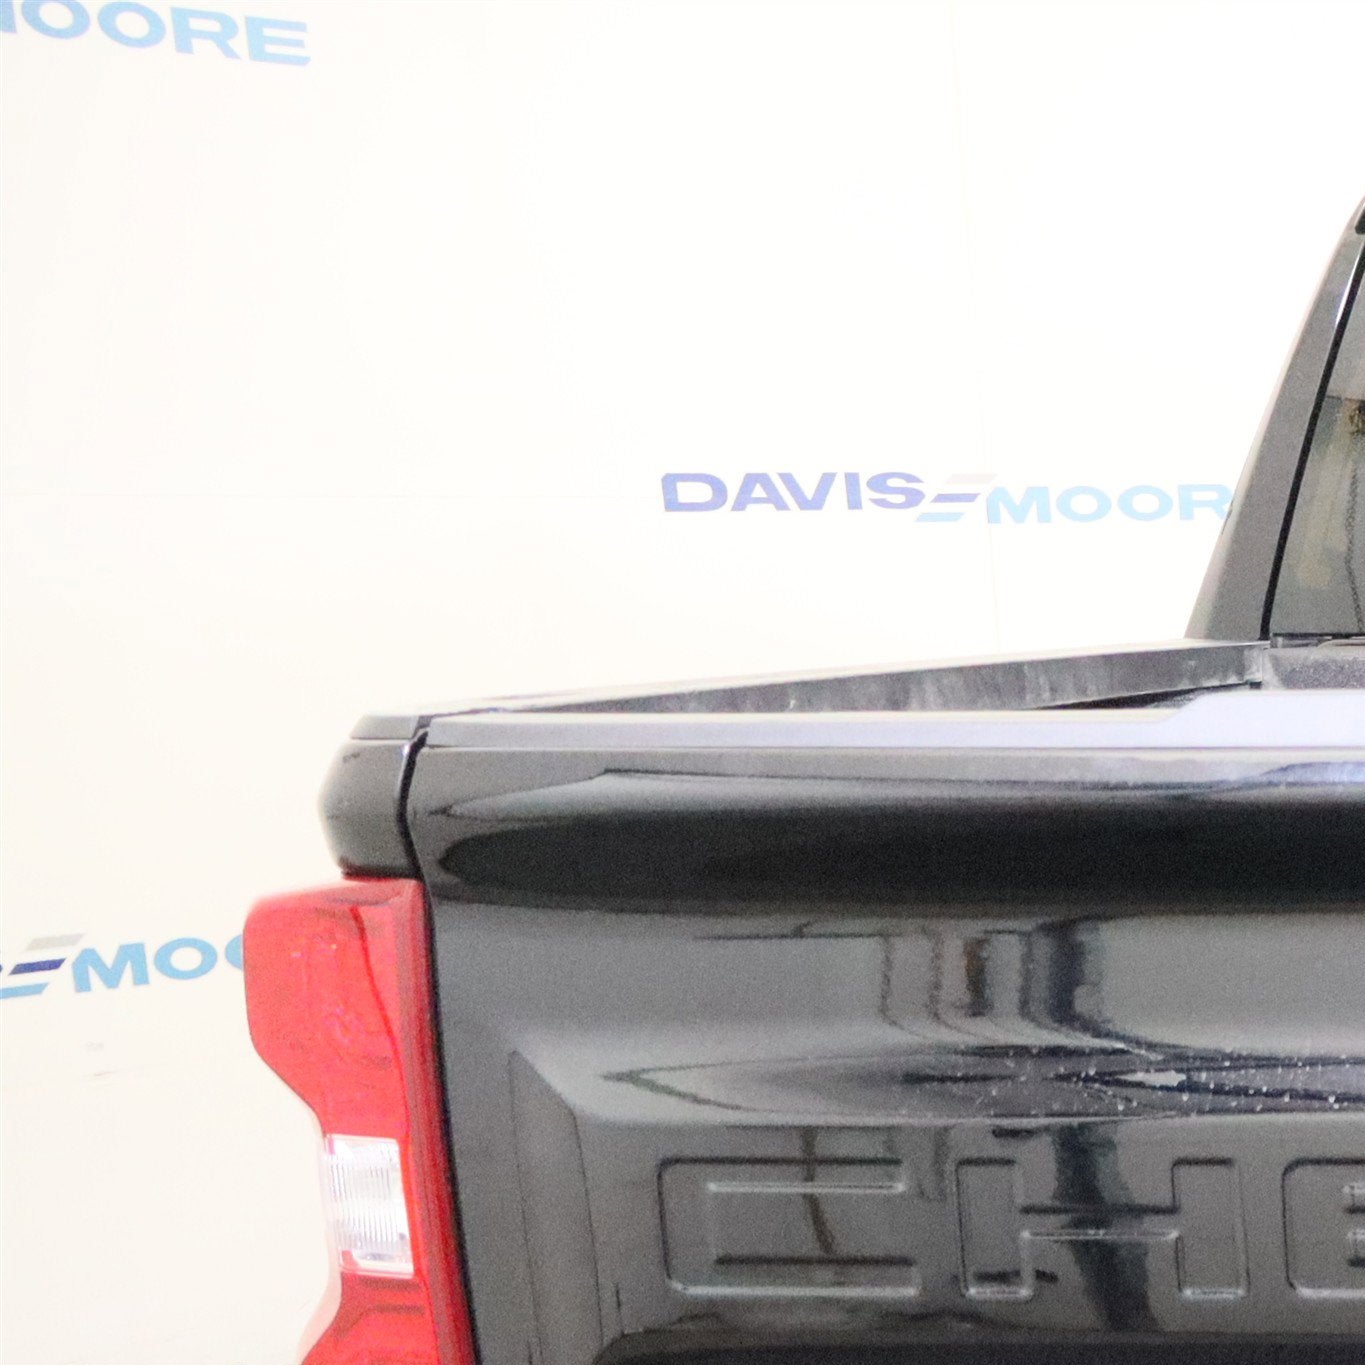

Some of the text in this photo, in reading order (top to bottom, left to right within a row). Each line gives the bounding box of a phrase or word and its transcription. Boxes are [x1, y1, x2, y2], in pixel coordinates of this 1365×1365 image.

[0, 0, 311, 66] OORE
[661, 471, 1234, 525] DAVIS MOOR
